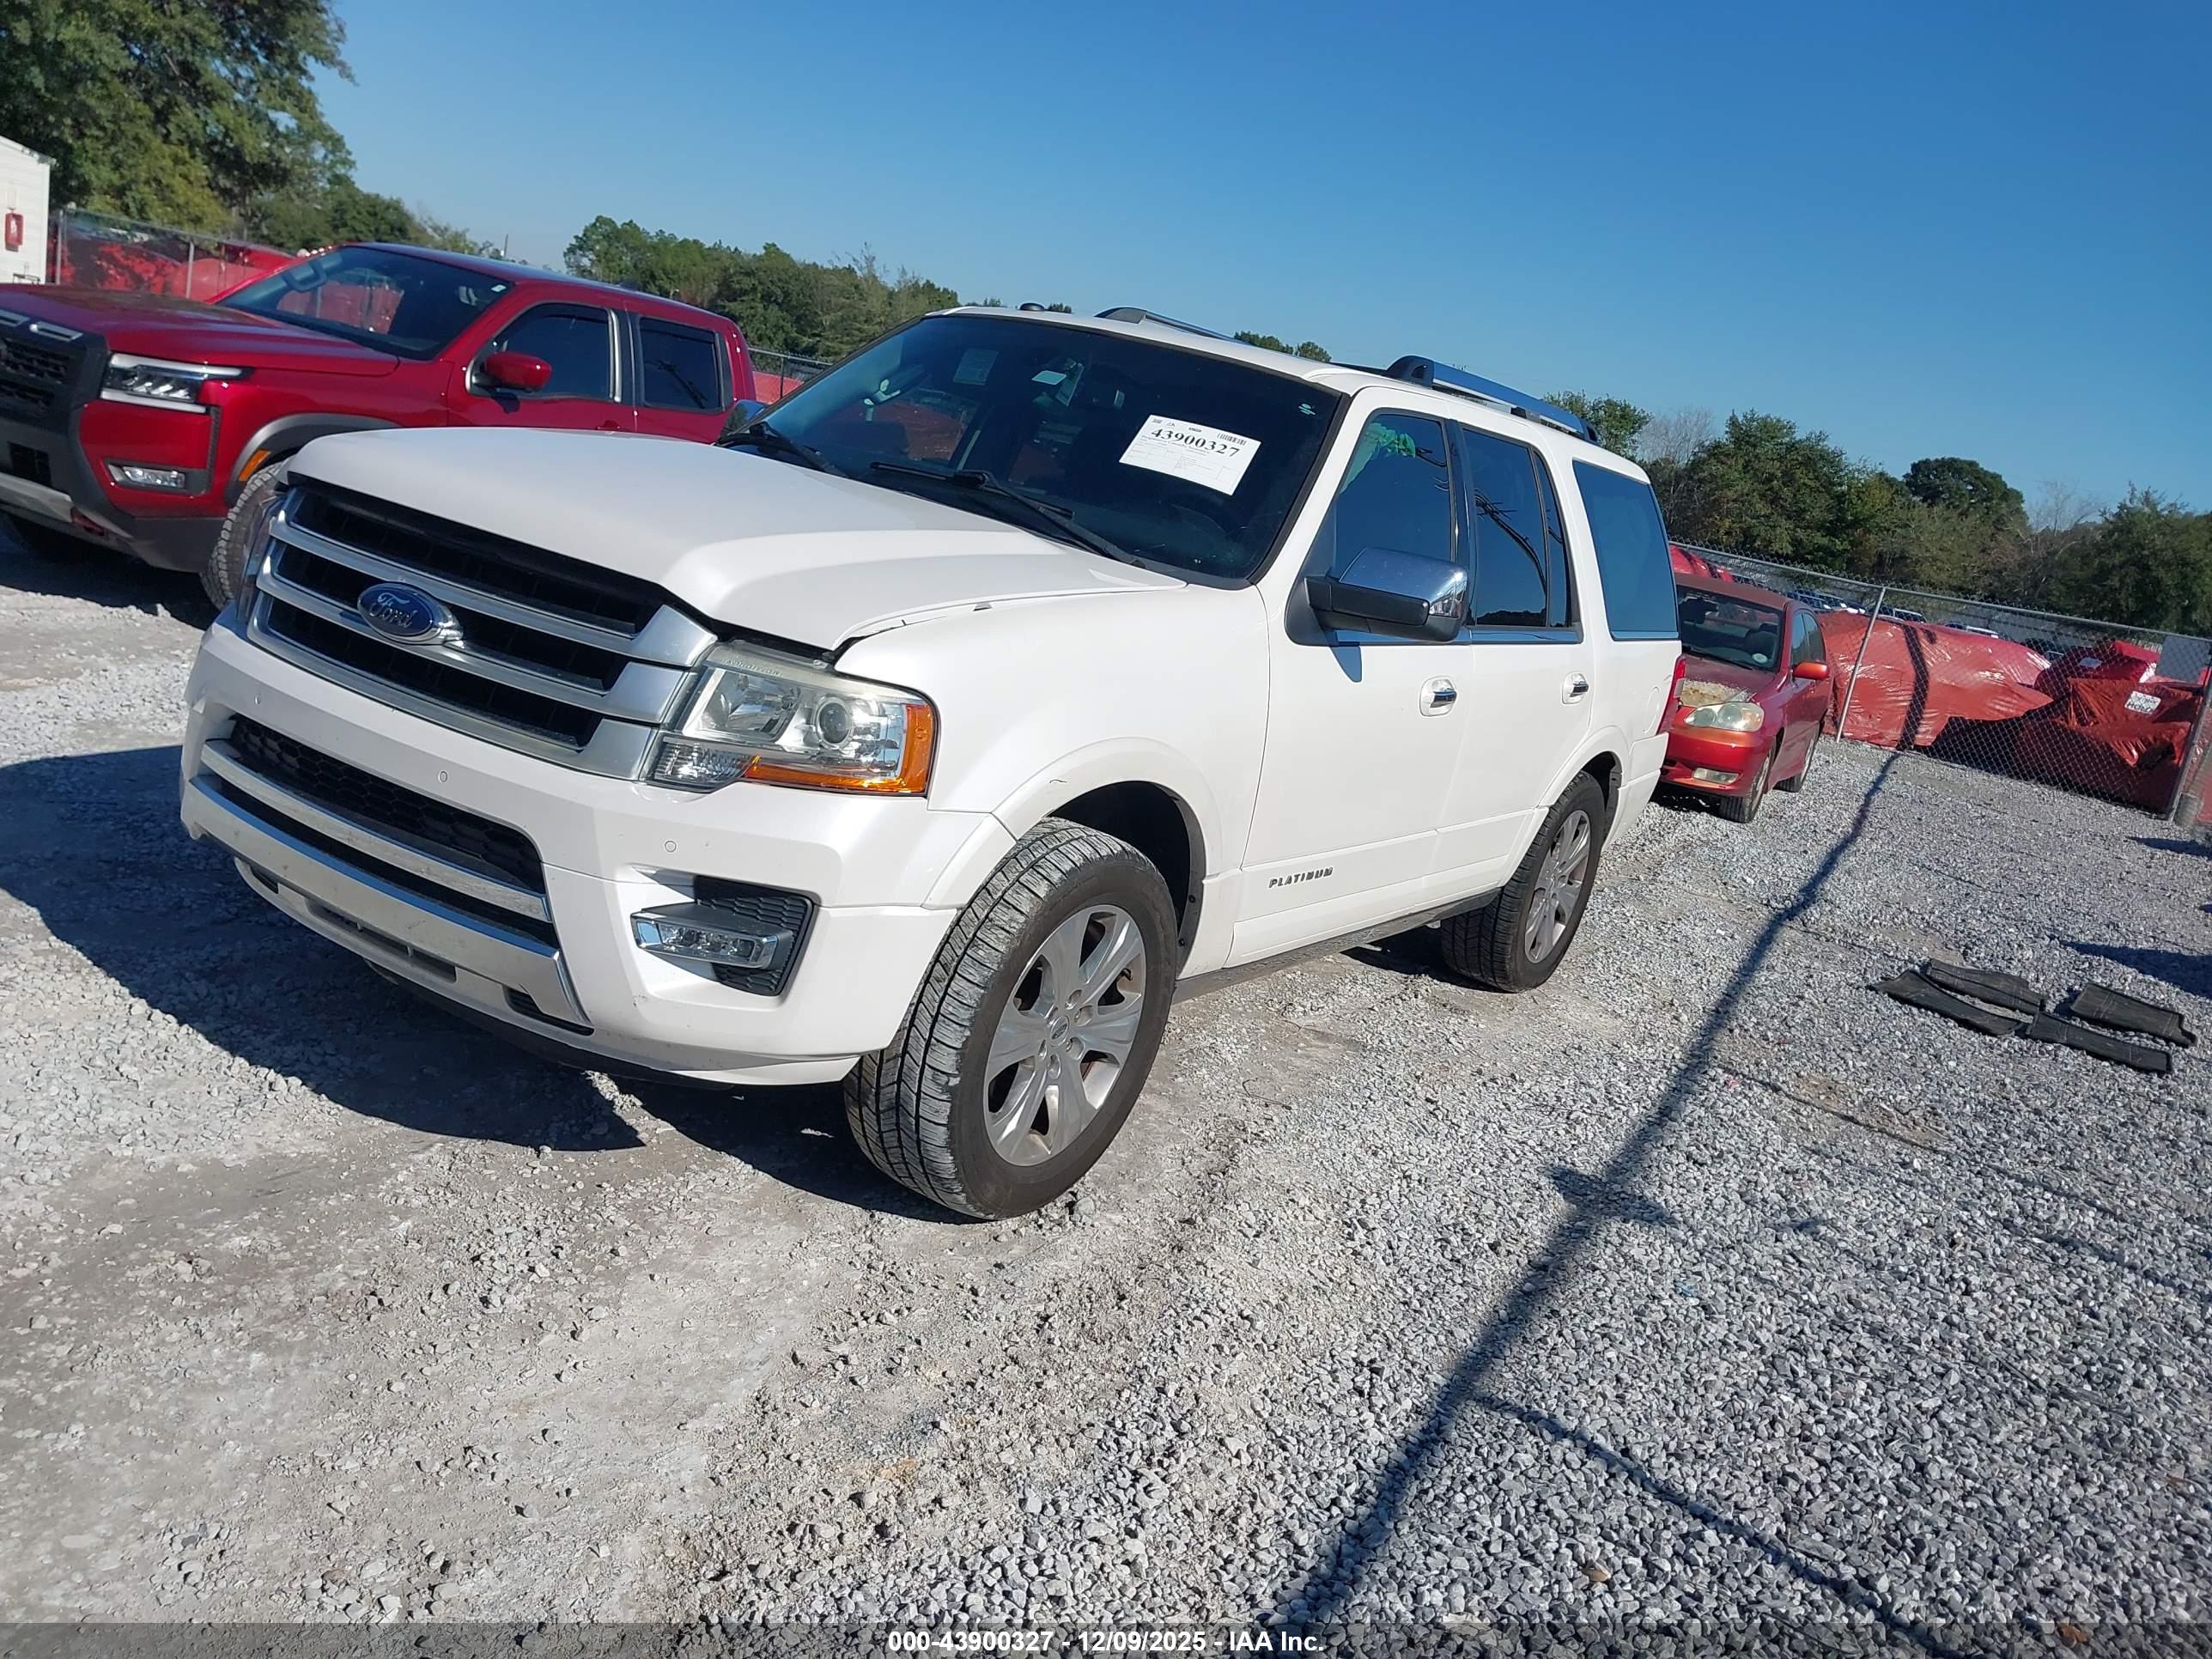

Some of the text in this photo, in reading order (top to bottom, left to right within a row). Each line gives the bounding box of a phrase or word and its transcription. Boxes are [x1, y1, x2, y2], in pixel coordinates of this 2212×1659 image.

[1151, 428, 1240, 457] 43900327
[369, 592, 418, 629] Ford
[1268, 866, 1334, 889] PLATINUM
